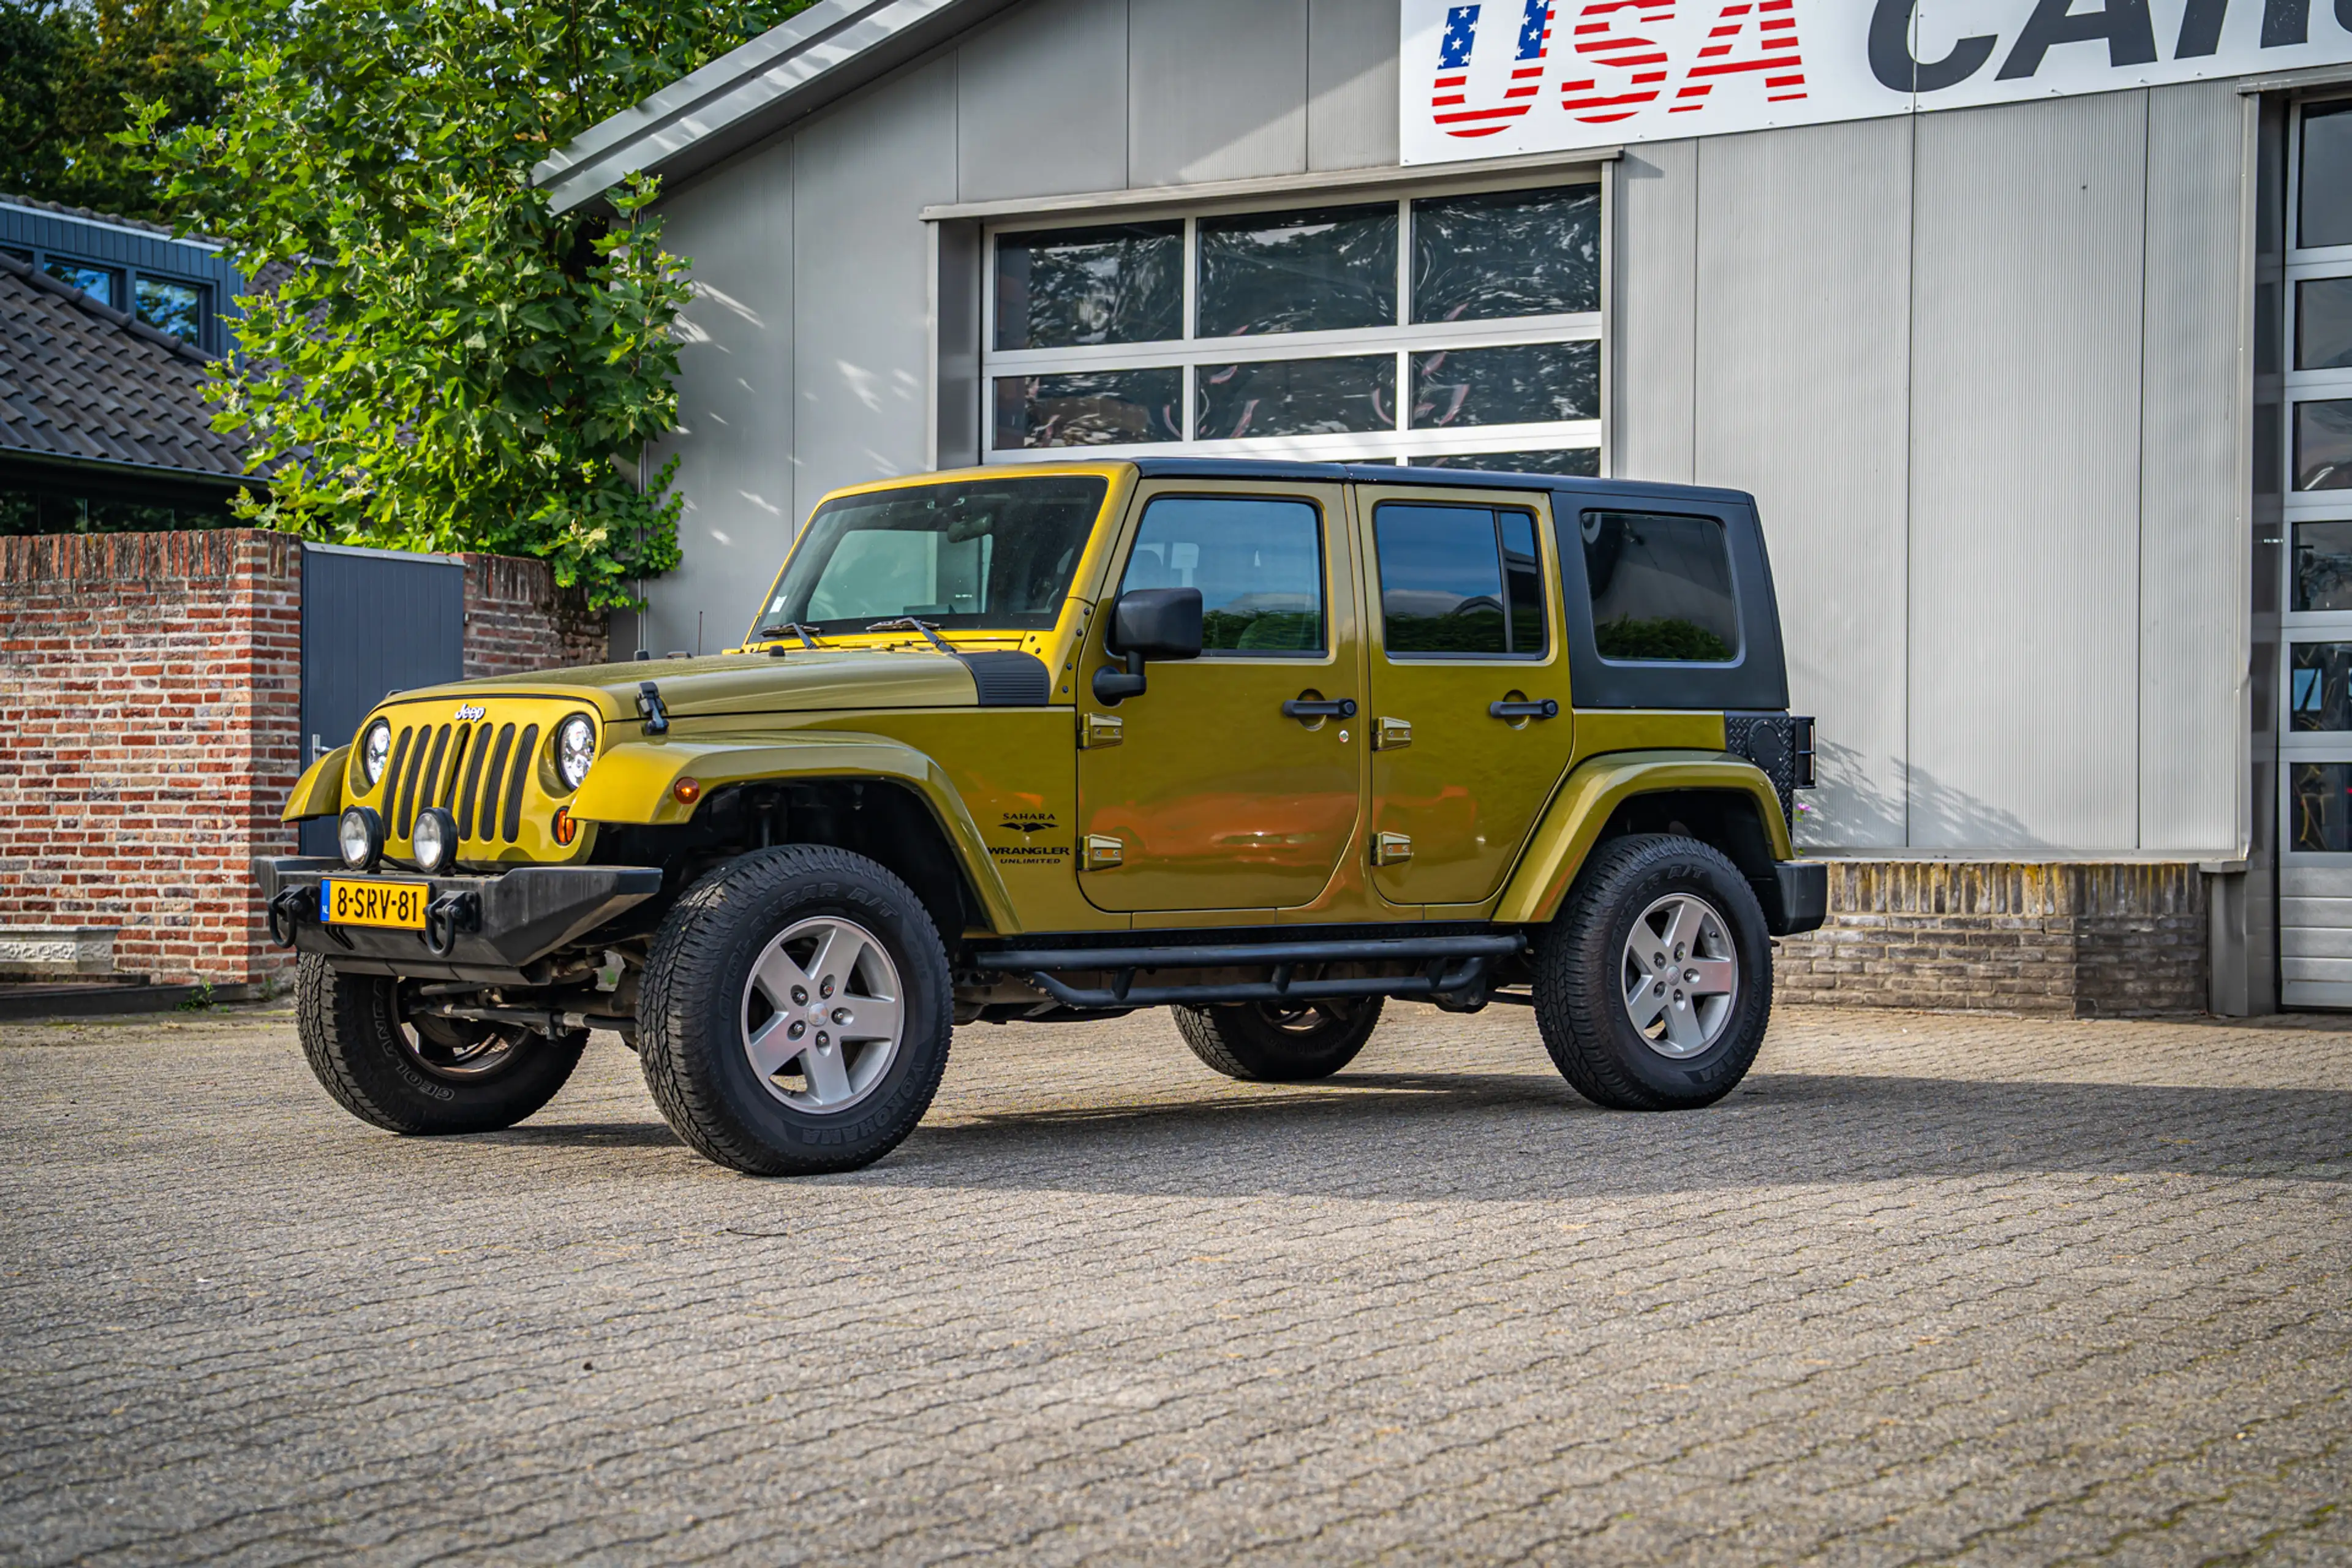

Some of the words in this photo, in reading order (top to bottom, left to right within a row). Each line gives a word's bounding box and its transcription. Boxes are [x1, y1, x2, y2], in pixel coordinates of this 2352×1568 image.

[1431, 0, 1808, 138] USA
[1868, 0, 2352, 93] CA
[454, 703, 486, 723] Jeep
[987, 846, 1070, 856] WRANGLER
[322, 905, 329, 914] NL
[337, 886, 418, 922] 8-SRV-81
[848, 886, 899, 918] A/T
[372, 978, 455, 1101] GEOLANDA
[802, 1062, 925, 1145] YOKOHAMA
